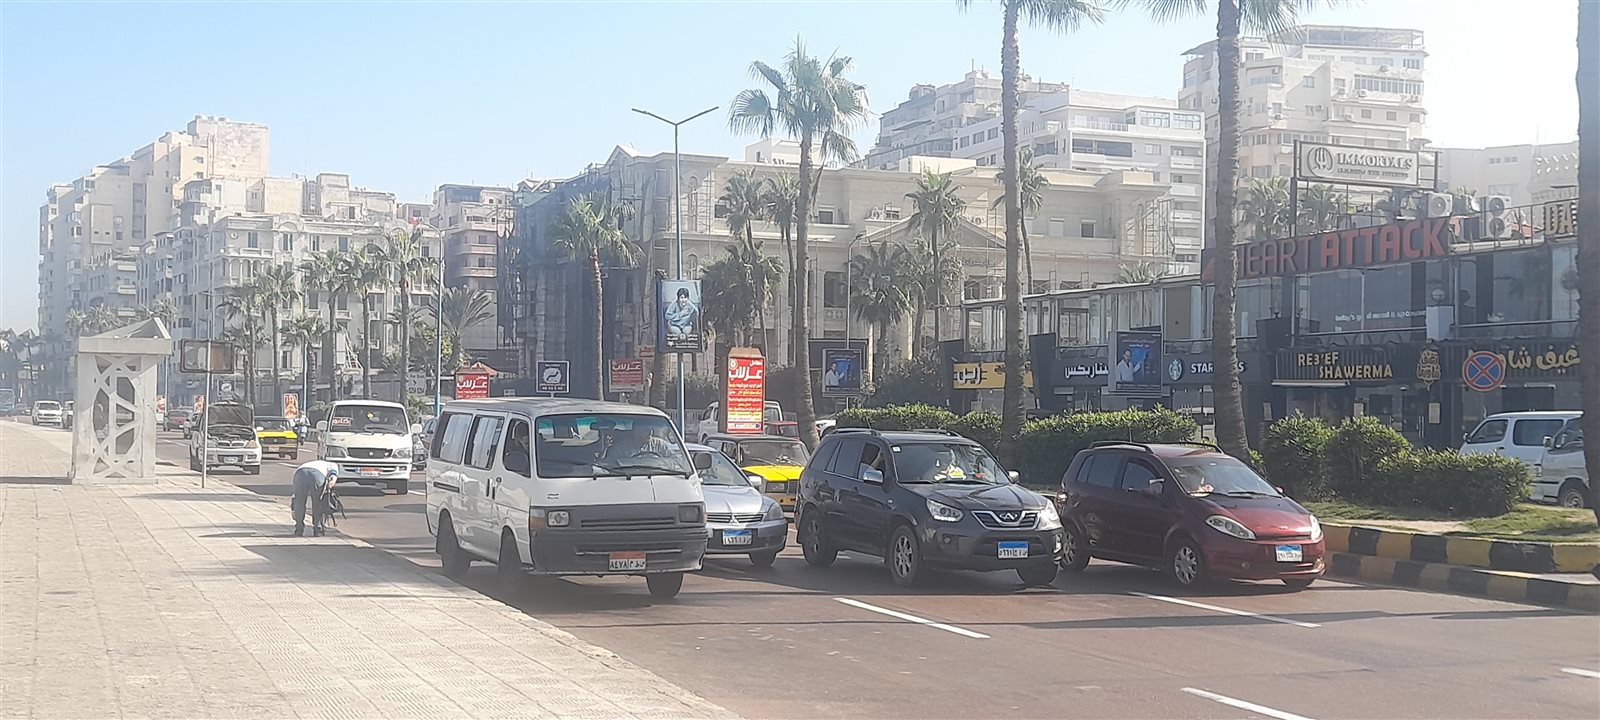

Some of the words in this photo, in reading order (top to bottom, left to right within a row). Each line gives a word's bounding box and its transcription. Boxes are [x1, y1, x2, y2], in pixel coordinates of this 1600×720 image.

[1337, 152, 1414, 169] IMMORTALS
[1544, 203, 1578, 234] DA
[1320, 219, 1448, 268] ATTACK
[1297, 351, 1339, 366] RE3'EF
[1536, 343, 1580, 375] غيف
[729, 366, 763, 382] عزلاب
[1191, 361, 1246, 374] STARS
[1320, 364, 1393, 379] SHAWERMA
